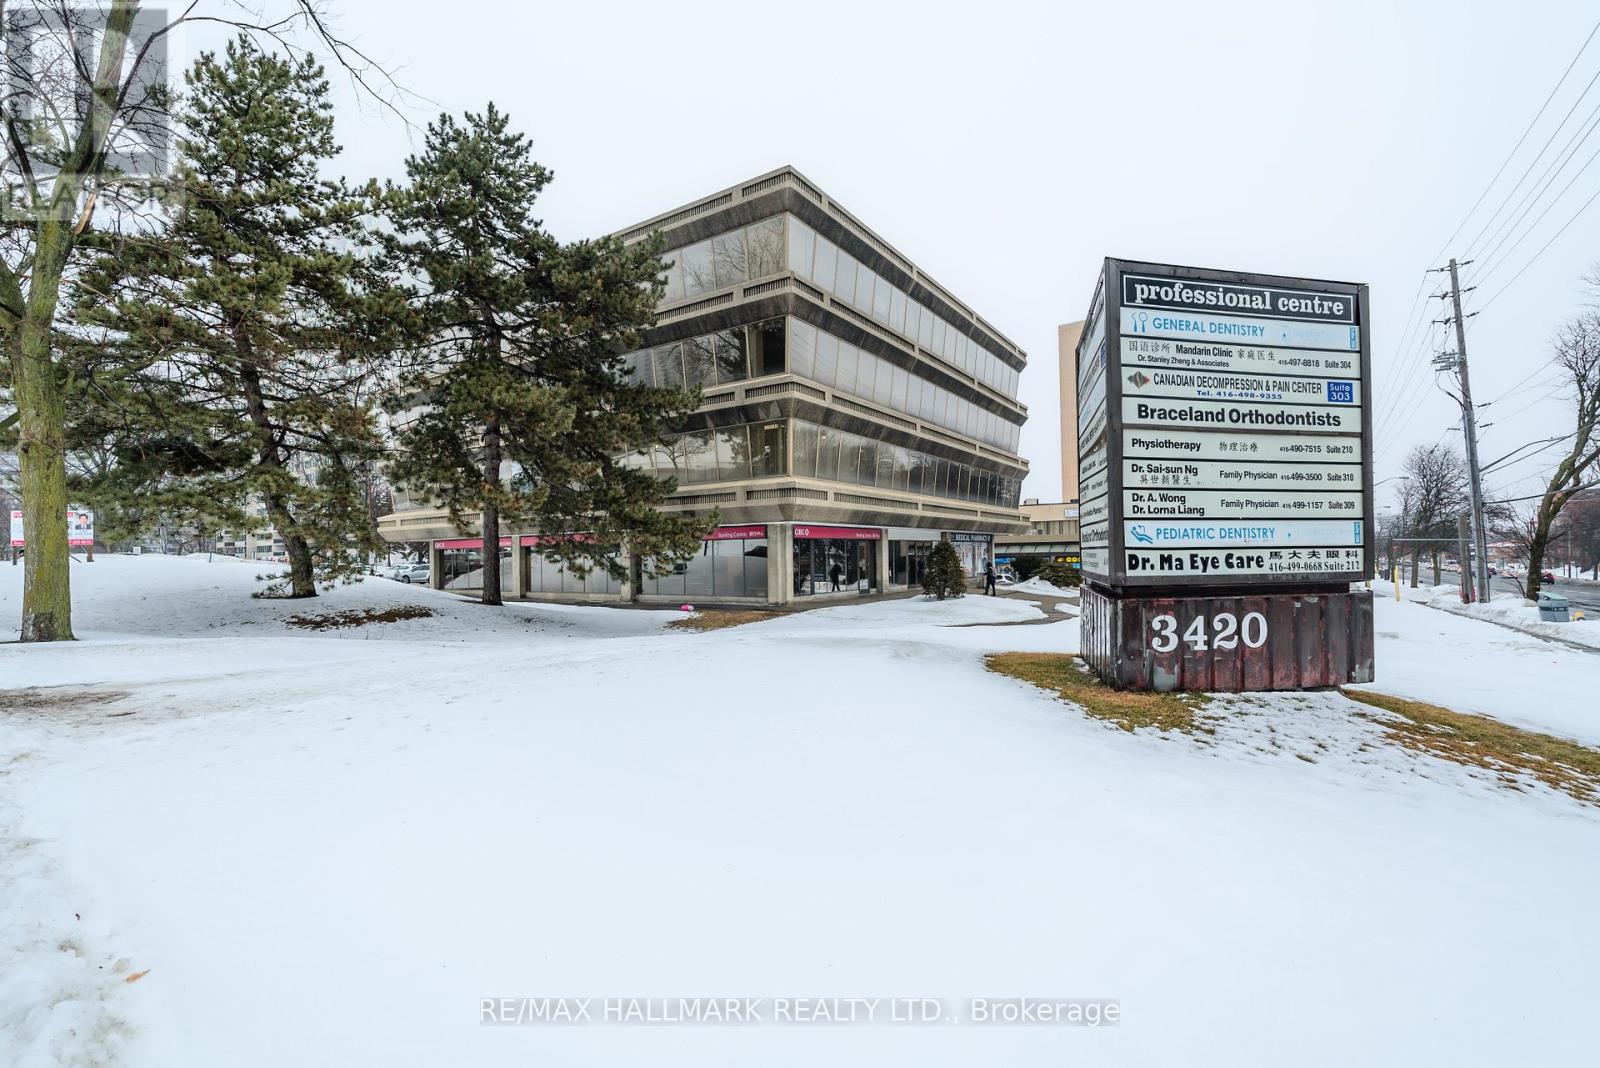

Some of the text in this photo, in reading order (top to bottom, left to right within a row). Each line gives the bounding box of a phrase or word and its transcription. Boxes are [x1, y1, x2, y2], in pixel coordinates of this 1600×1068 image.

[1134, 282, 1344, 315] professional centre
[1152, 318, 1264, 336] GENERAL DENTISTRY
[1129, 340, 1276, 360] 国语诊所 Mandarin Clinic 家庭医生
[1138, 355, 1148, 363] Dr.
[1148, 356, 1170, 366] Stanley
[1170, 358, 1190, 367] Zheng
[1197, 359, 1229, 368] Associates
[1324, 359, 1338, 369] Suite
[1339, 360, 1351, 369] 304
[1154, 373, 1321, 394] CANADIAN DECOMPRESSION & PAIN CENTER
[1330, 384, 1350, 392] Suite
[1216, 391, 1282, 399] 416-498-9355
[1331, 392, 1350, 400] 303
[1138, 404, 1341, 427] Braceland Orthodontists
[1132, 439, 1201, 452] Physiotherapy
[1219, 441, 1258, 452] 物理治療
[1327, 445, 1340, 454] Suite
[1341, 446, 1353, 454] 210
[1132, 464, 1198, 476] Dr. Sai-sun Ng
[1220, 470, 1242, 480] Family
[1244, 471, 1278, 480] Physician
[1327, 473, 1341, 482] Suite
[1342, 474, 1354, 482] 310
[1132, 493, 1186, 504] Dr. A. Wong
[1132, 506, 1204, 516] Dr. Lorna Liang
[1220, 500, 1243, 509] Family
[1245, 500, 1279, 509] Physician
[1328, 501, 1342, 510] Suite
[1343, 502, 1354, 510] 309
[1156, 527, 1275, 539] PEDIATRIC DENTISTRY
[1269, 551, 1358, 560] 馬大夫眼科
[1128, 553, 1264, 572] Dr. Ma Eye Care
[1269, 560, 1360, 572] 416-499-0668 Suite 212
[1152, 612, 1268, 652] 3420
